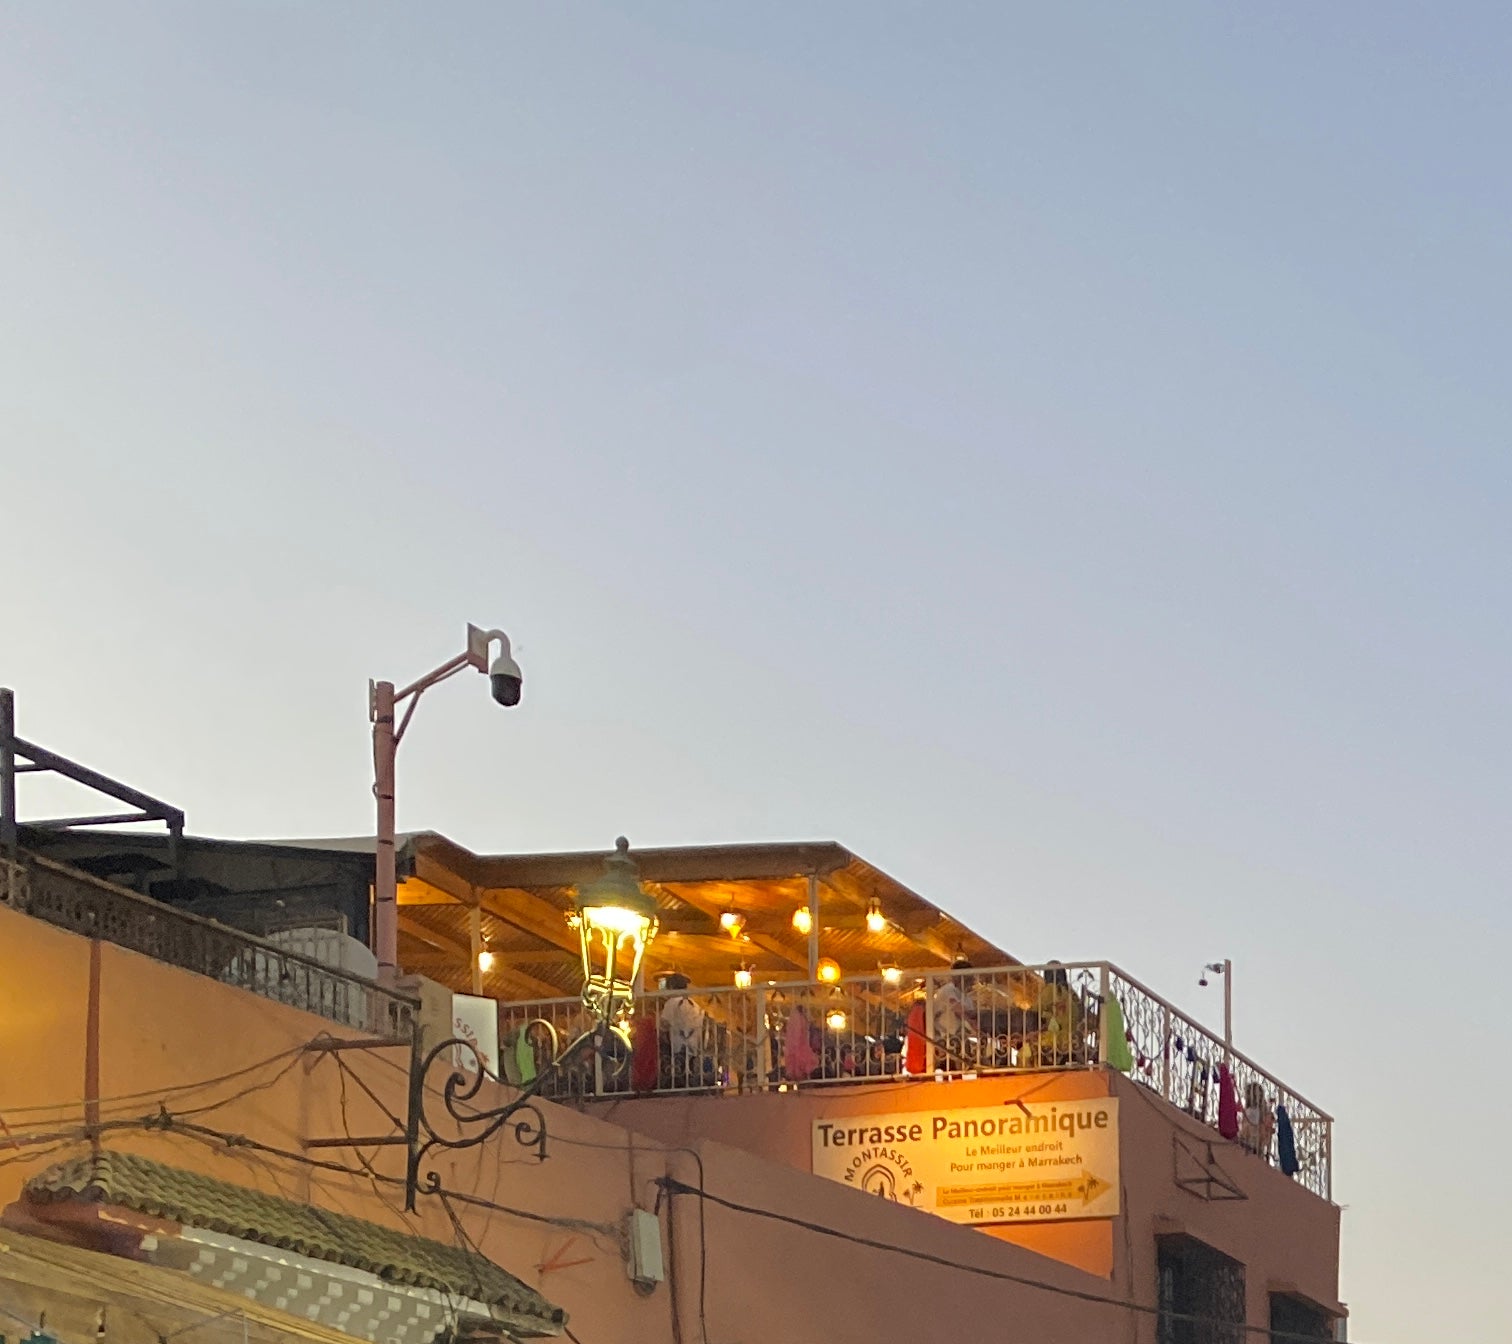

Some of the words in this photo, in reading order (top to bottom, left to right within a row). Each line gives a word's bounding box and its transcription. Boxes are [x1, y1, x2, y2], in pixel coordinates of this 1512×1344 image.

[817, 1123, 923, 1147] Terrasse
[932, 1107, 1109, 1139] Panoramique
[965, 1147, 977, 1157] Le
[980, 1144, 1022, 1156] Meilleur
[1025, 1141, 1064, 1152] endroit
[844, 1146, 913, 1182] MONTASSIR
[950, 1162, 973, 1172] Pour
[976, 1160, 1015, 1172] manger
[1018, 1159, 1025, 1168] à
[1028, 1154, 1083, 1168] Marrakech
[992, 1207, 1005, 1218] 05
[1008, 1206, 1020, 1216] 24
[1023, 1205, 1036, 1216] 44
[1038, 1204, 1052, 1215] 00
[1054, 1203, 1067, 1214] 44
